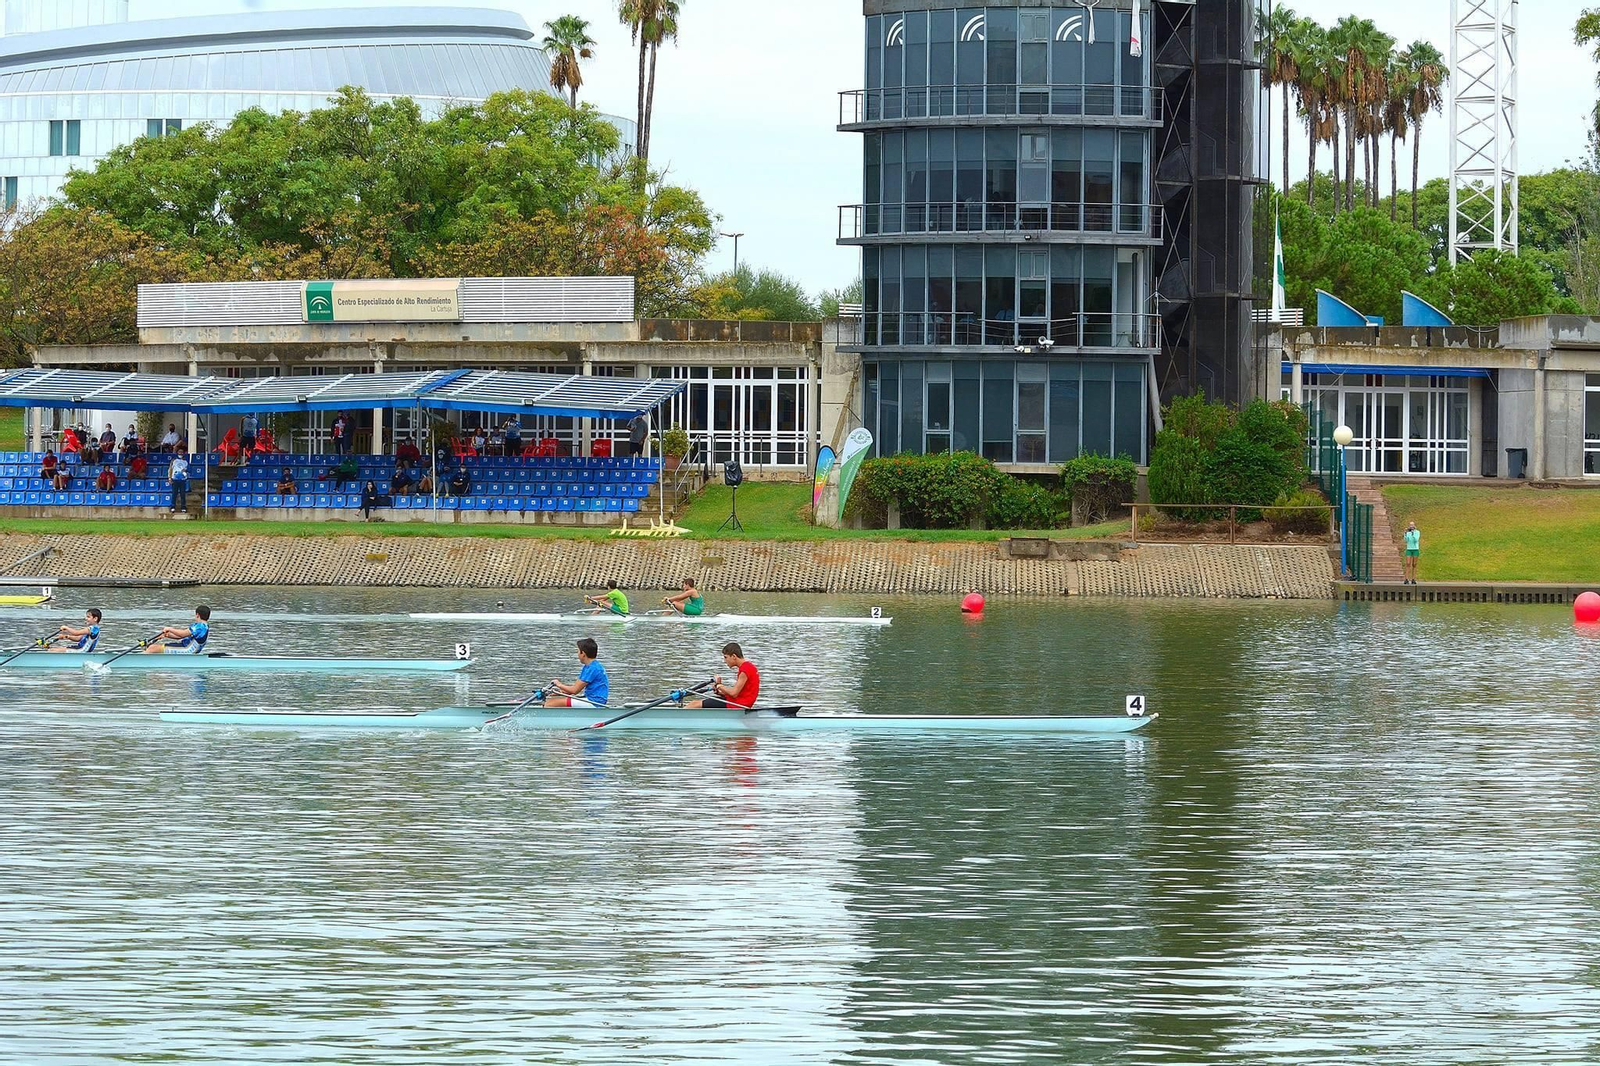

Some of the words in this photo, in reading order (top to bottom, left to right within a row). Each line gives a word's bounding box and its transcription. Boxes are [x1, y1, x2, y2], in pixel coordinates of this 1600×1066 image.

[337, 298, 356, 306] Centro
[357, 297, 395, 307] Especializado
[396, 297, 403, 305] de
[404, 297, 415, 305] Alto
[416, 296, 452, 305] Rendimiento
[873, 607, 880, 616] 2
[459, 644, 467, 656] 3
[1130, 696, 1142, 711] 4
